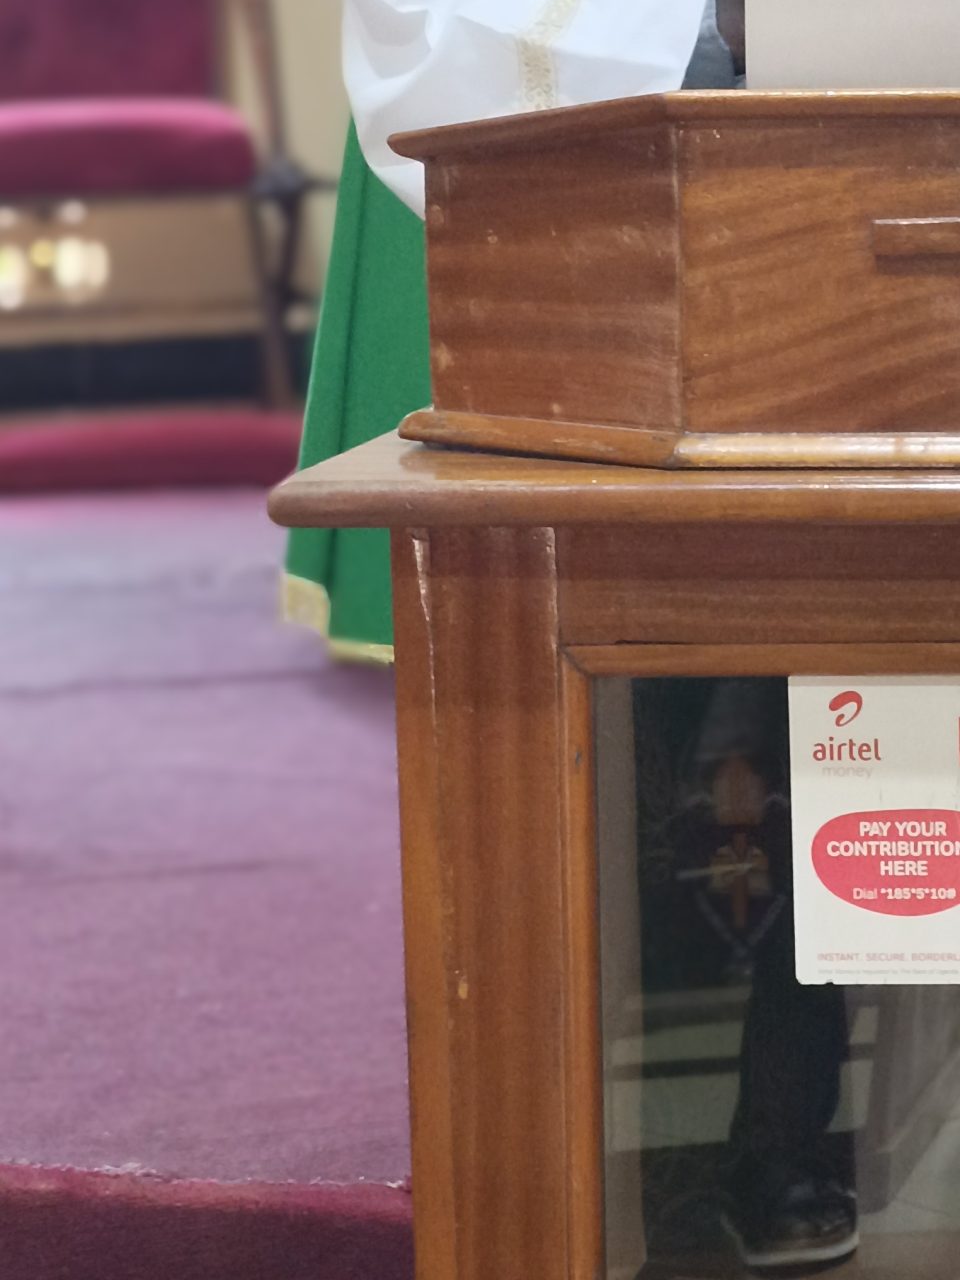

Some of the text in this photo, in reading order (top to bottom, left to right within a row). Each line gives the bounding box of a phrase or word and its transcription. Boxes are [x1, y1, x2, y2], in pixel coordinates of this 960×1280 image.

[812, 736, 882, 761] airtel
[821, 766, 874, 779] money
[859, 821, 947, 837] PAY YOUR
[879, 860, 929, 876] HERE
[852, 887, 878, 900] Dial
